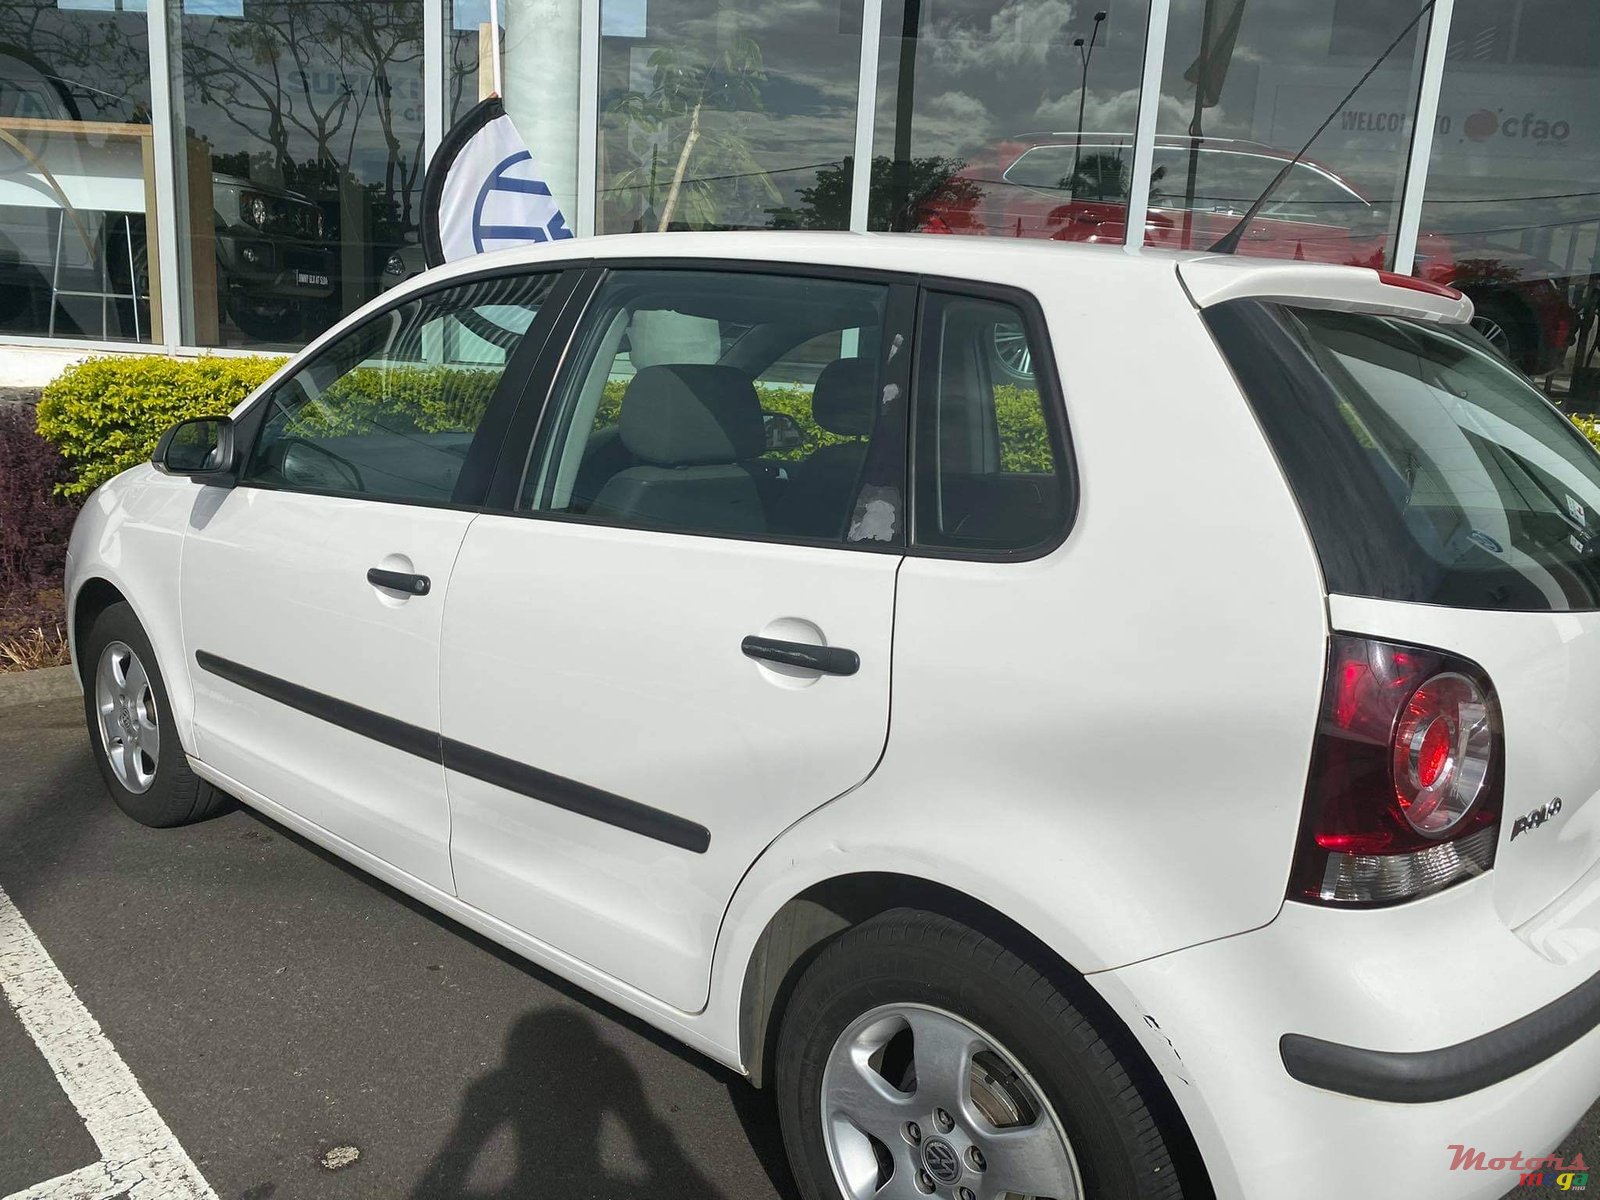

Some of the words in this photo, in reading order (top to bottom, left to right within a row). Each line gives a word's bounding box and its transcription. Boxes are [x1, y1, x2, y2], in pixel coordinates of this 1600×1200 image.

[1341, 110, 1406, 132] WELCO
[1501, 112, 1571, 141] cfao
[1510, 796, 1562, 842] POLO
